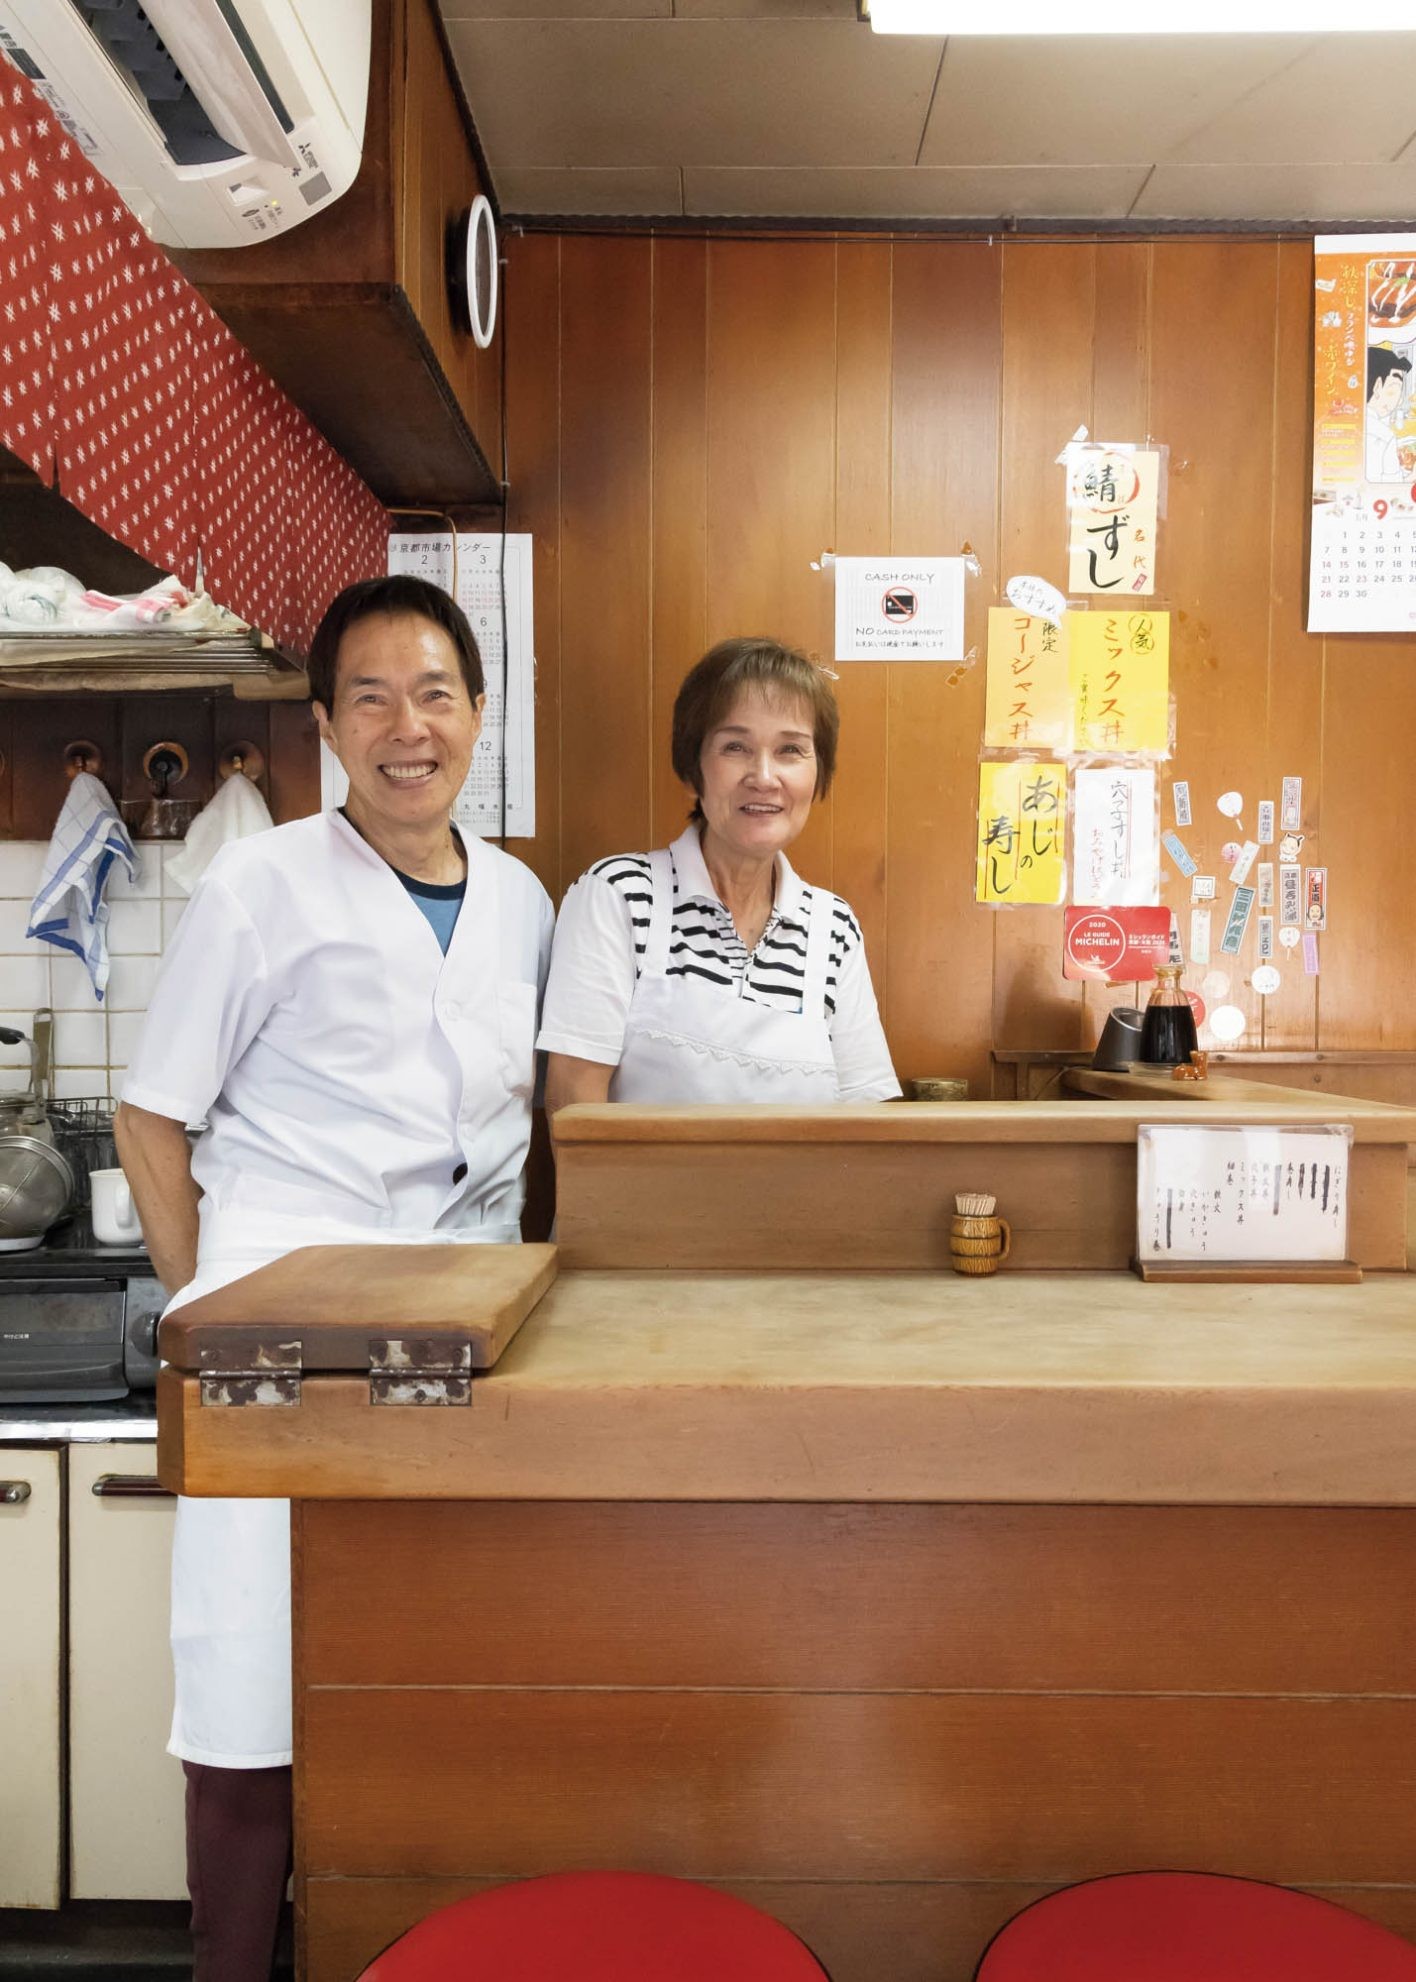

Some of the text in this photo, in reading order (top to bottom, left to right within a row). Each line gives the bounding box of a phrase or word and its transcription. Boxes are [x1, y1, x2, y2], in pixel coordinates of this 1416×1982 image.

[1373, 499, 1388, 520] 9
[1359, 531, 1366, 539] 2
[1395, 531, 1400, 539] 4
[1324, 546, 1330, 554] 7
[1375, 546, 1384, 554] 10
[421, 555, 487, 565] 2 3
[865, 573, 934, 583] CASH ONLY
[1338, 590, 1349, 598] 29
[480, 617, 487, 627] 6
[480, 741, 492, 751] 12
[1075, 938, 1120, 946] MICHELIN
